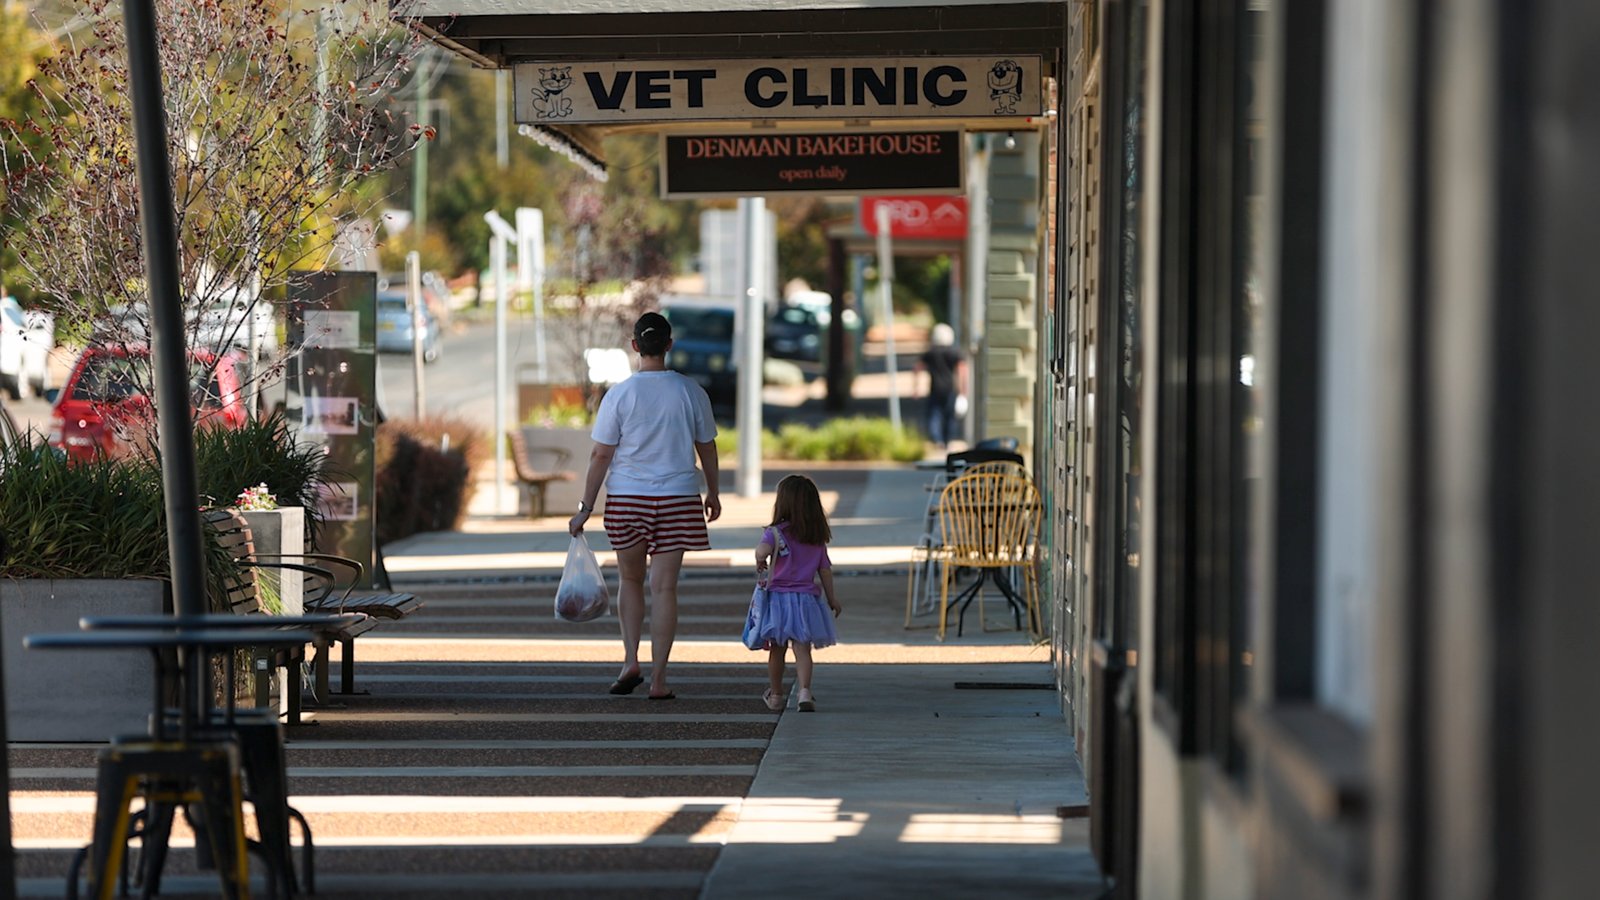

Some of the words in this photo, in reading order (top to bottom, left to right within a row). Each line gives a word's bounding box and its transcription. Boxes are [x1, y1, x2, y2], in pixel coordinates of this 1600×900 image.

[582, 69, 717, 111] VET
[743, 64, 969, 109] CLINIC
[685, 137, 792, 158] DENMAN
[796, 134, 942, 156] BAKEHOUSE
[779, 168, 813, 182] open
[815, 165, 848, 181] daily
